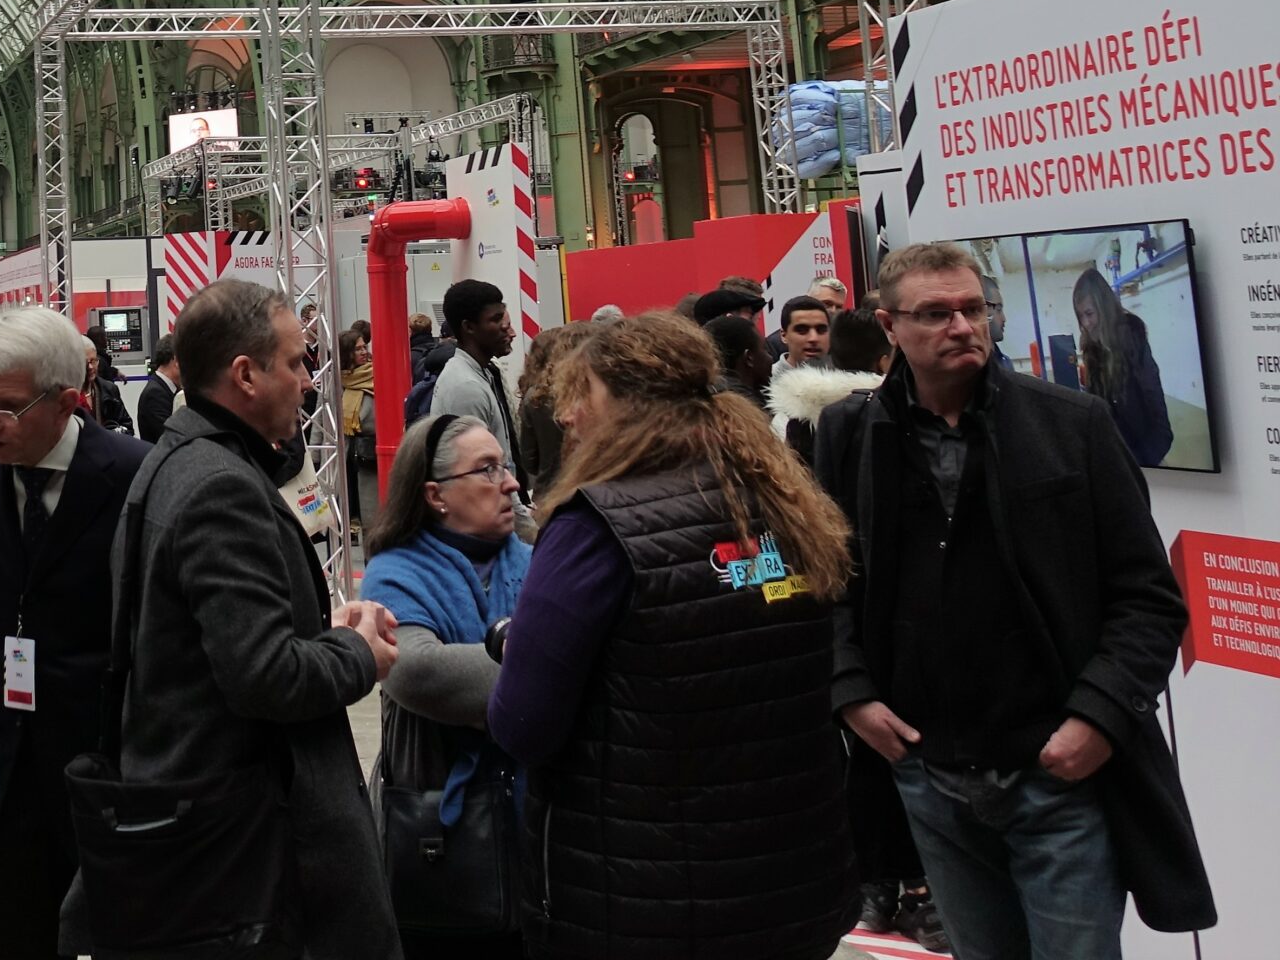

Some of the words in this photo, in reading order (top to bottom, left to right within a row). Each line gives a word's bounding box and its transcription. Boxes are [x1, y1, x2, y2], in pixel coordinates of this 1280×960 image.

[934, 31, 1139, 110] L'EXTRAORDINAIRE
[1143, 10, 1202, 67] DÉFI
[939, 118, 977, 159] DES
[982, 92, 1113, 153] INDUSTRIES
[1118, 62, 1280, 130] MÉCANIQUE
[944, 170, 967, 208] ET
[972, 135, 1212, 206] TRANSFORMATRICES
[1219, 126, 1276, 176] DES
[234, 256, 260, 269] AGORA
[814, 253, 834, 265] FRA
[1203, 552, 1217, 568] EN
[1218, 554, 1279, 578] CONCLUSION
[1205, 576, 1255, 598] TRAVAILLER
[1256, 580, 1263, 599] À
[1208, 595, 1229, 610] D'UN
[1229, 599, 1260, 617] MONDE
[1260, 604, 1276, 620] QUI
[1211, 614, 1228, 630] AUX
[1229, 615, 1253, 635] DÉFIS
[1212, 632, 1223, 647] ET
